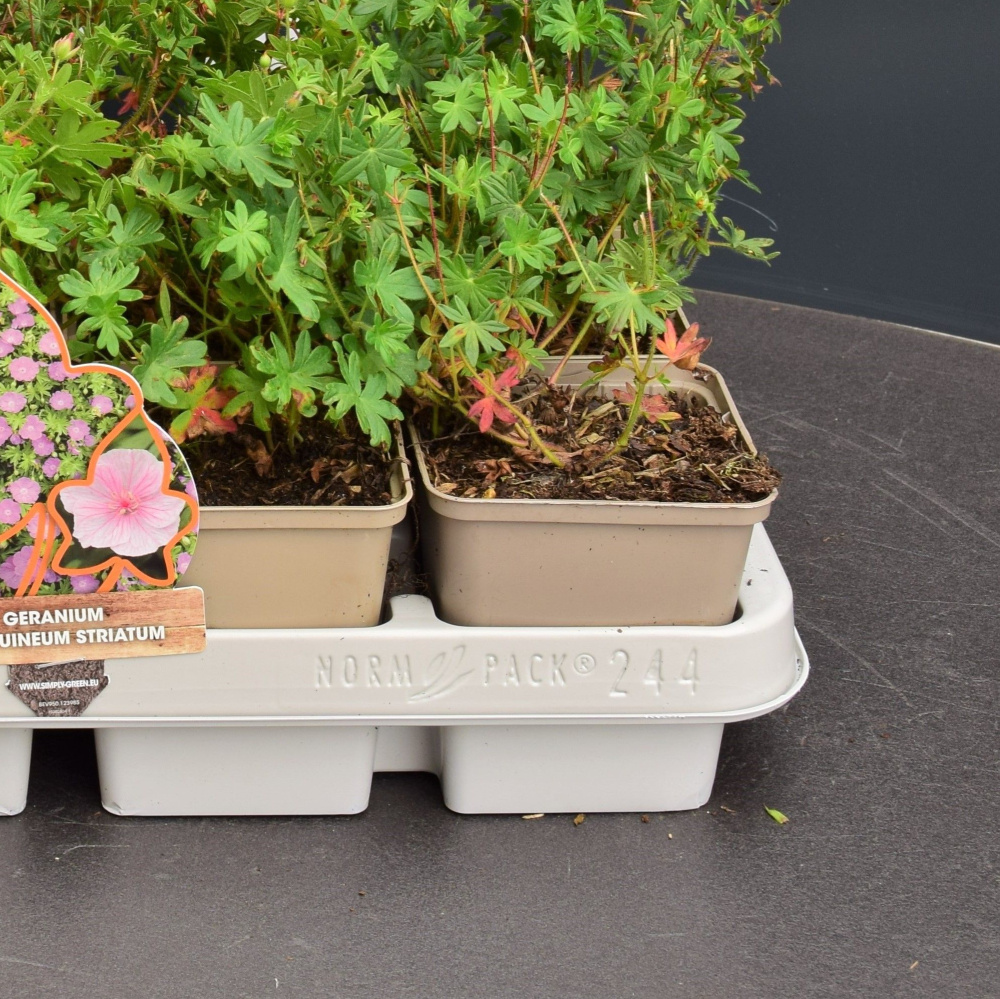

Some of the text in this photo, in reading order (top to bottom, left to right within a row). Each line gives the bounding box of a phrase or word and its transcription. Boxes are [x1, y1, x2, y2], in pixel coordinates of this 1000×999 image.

[3, 608, 104, 626] GERANIUM
[75, 625, 166, 644] STRIATUM
[314, 654, 413, 688] NORM
[608, 647, 701, 697] 244
[18, 678, 99, 691] WWW.SIMPLY-GREEN.EU
